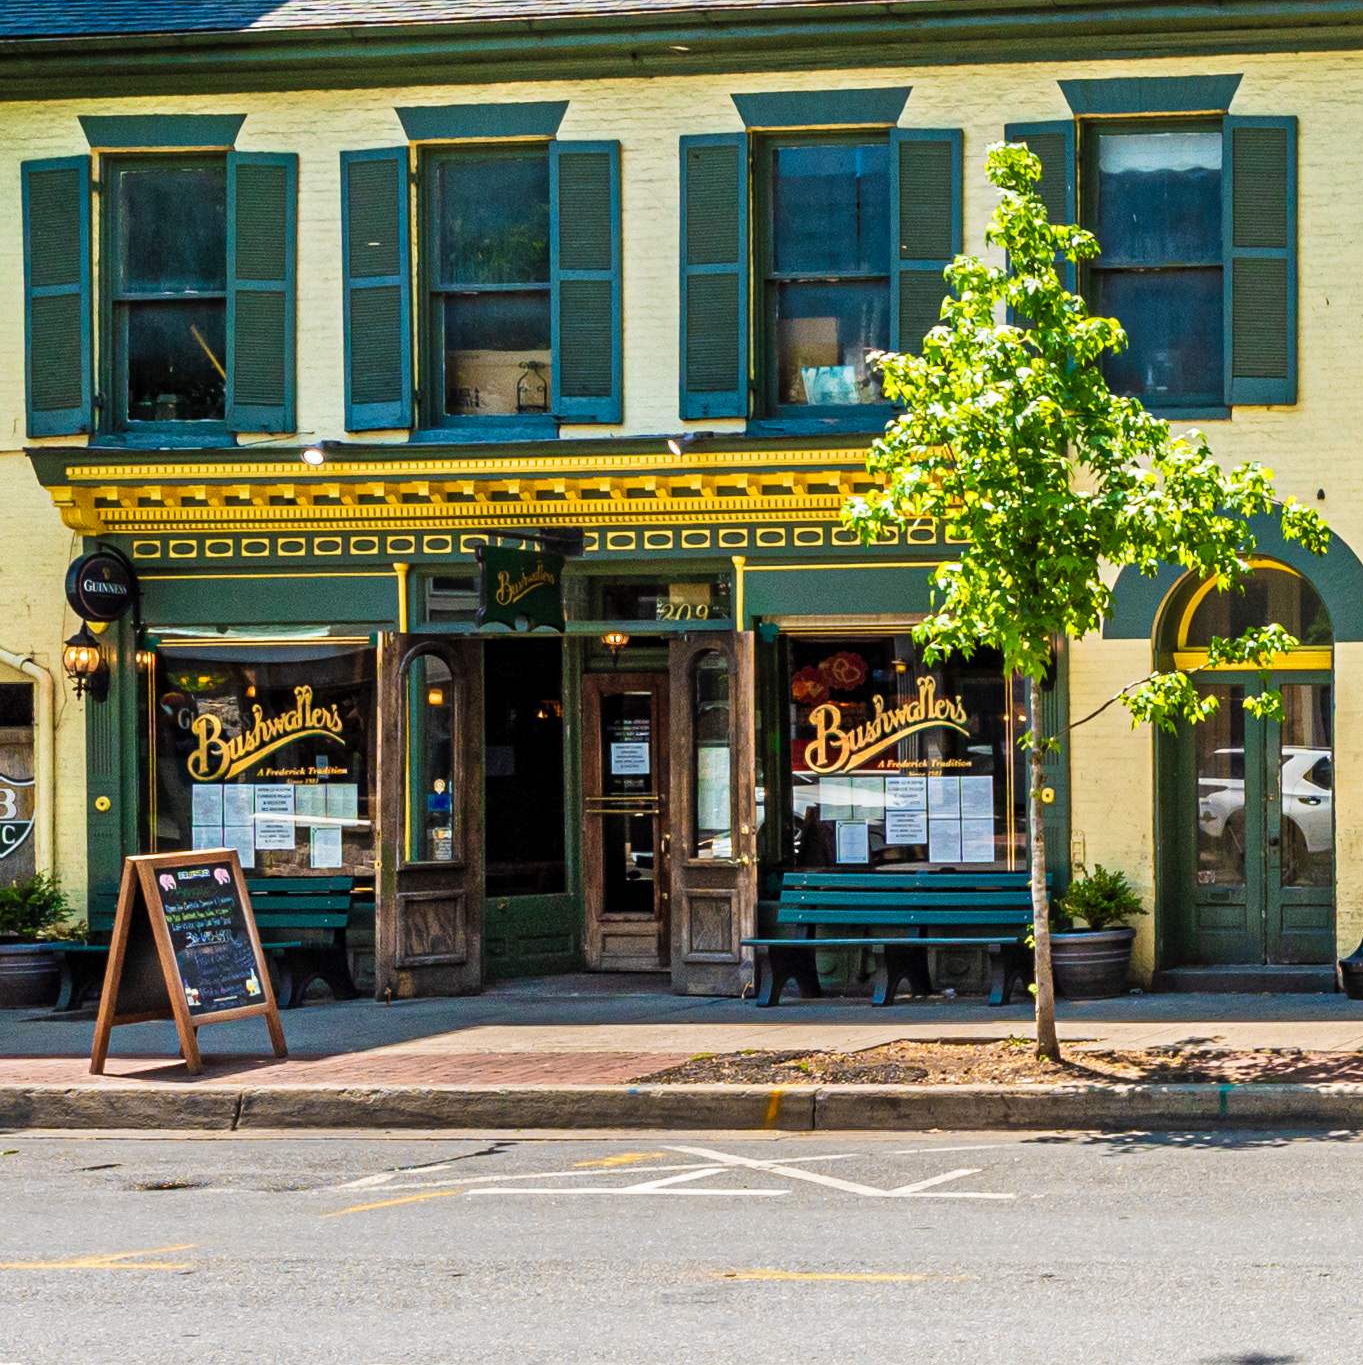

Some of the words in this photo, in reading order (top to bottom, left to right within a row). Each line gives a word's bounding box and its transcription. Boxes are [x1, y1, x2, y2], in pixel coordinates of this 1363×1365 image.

[84, 579, 127, 595] GUINNESS
[187, 685, 343, 780] Bushwaller's
[805, 675, 967, 774] Bushwaller's
[877, 759, 885, 768] A
[887, 758, 928, 768] Frederick
[931, 758, 972, 767] Tradition
[257, 768, 264, 776] A
[266, 767, 305, 776] Frederick
[308, 767, 348, 775] Tradition
